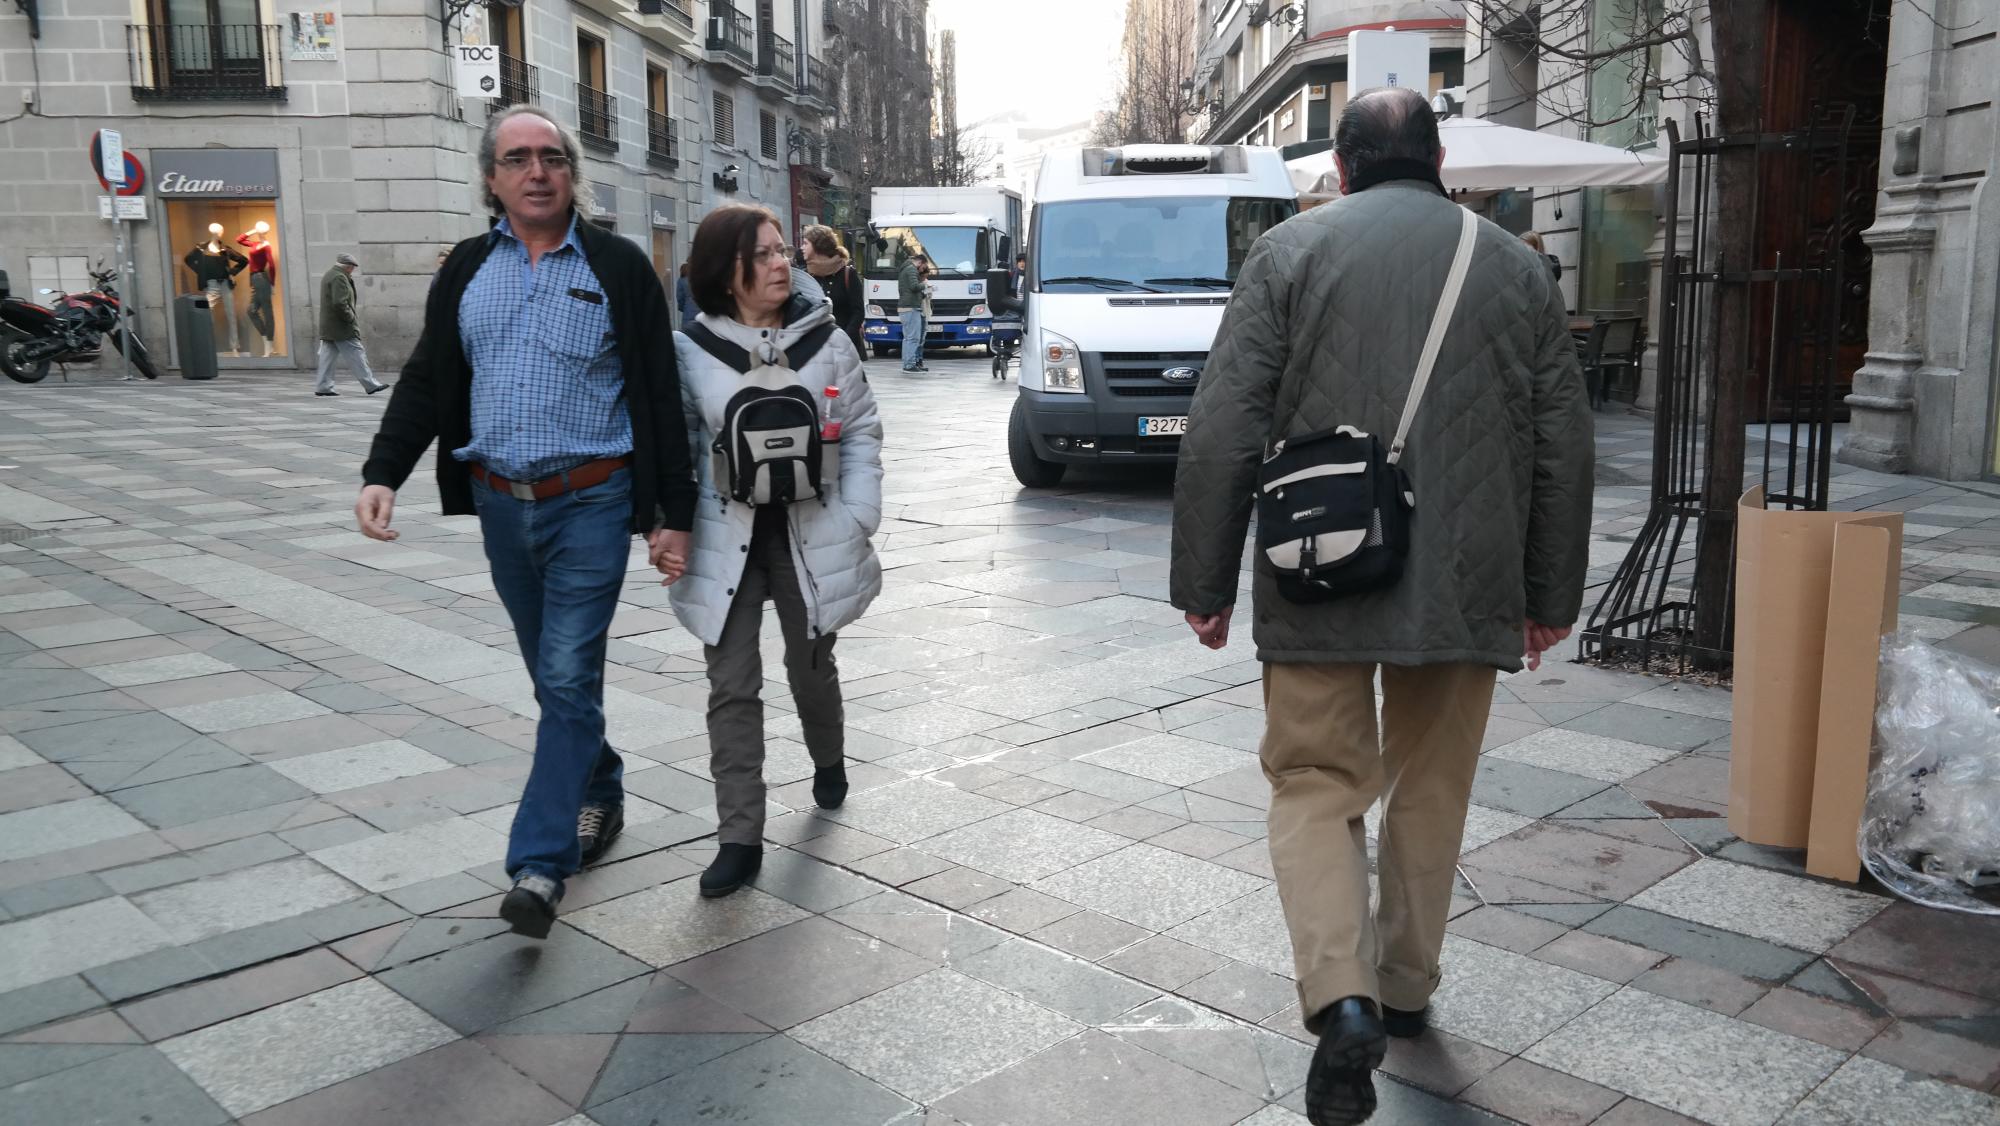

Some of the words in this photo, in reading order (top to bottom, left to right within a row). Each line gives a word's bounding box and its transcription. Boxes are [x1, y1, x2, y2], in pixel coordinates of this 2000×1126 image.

[459, 46, 493, 61] TOC
[158, 171, 225, 193] Etam
[1150, 418, 1188, 433] 3276
